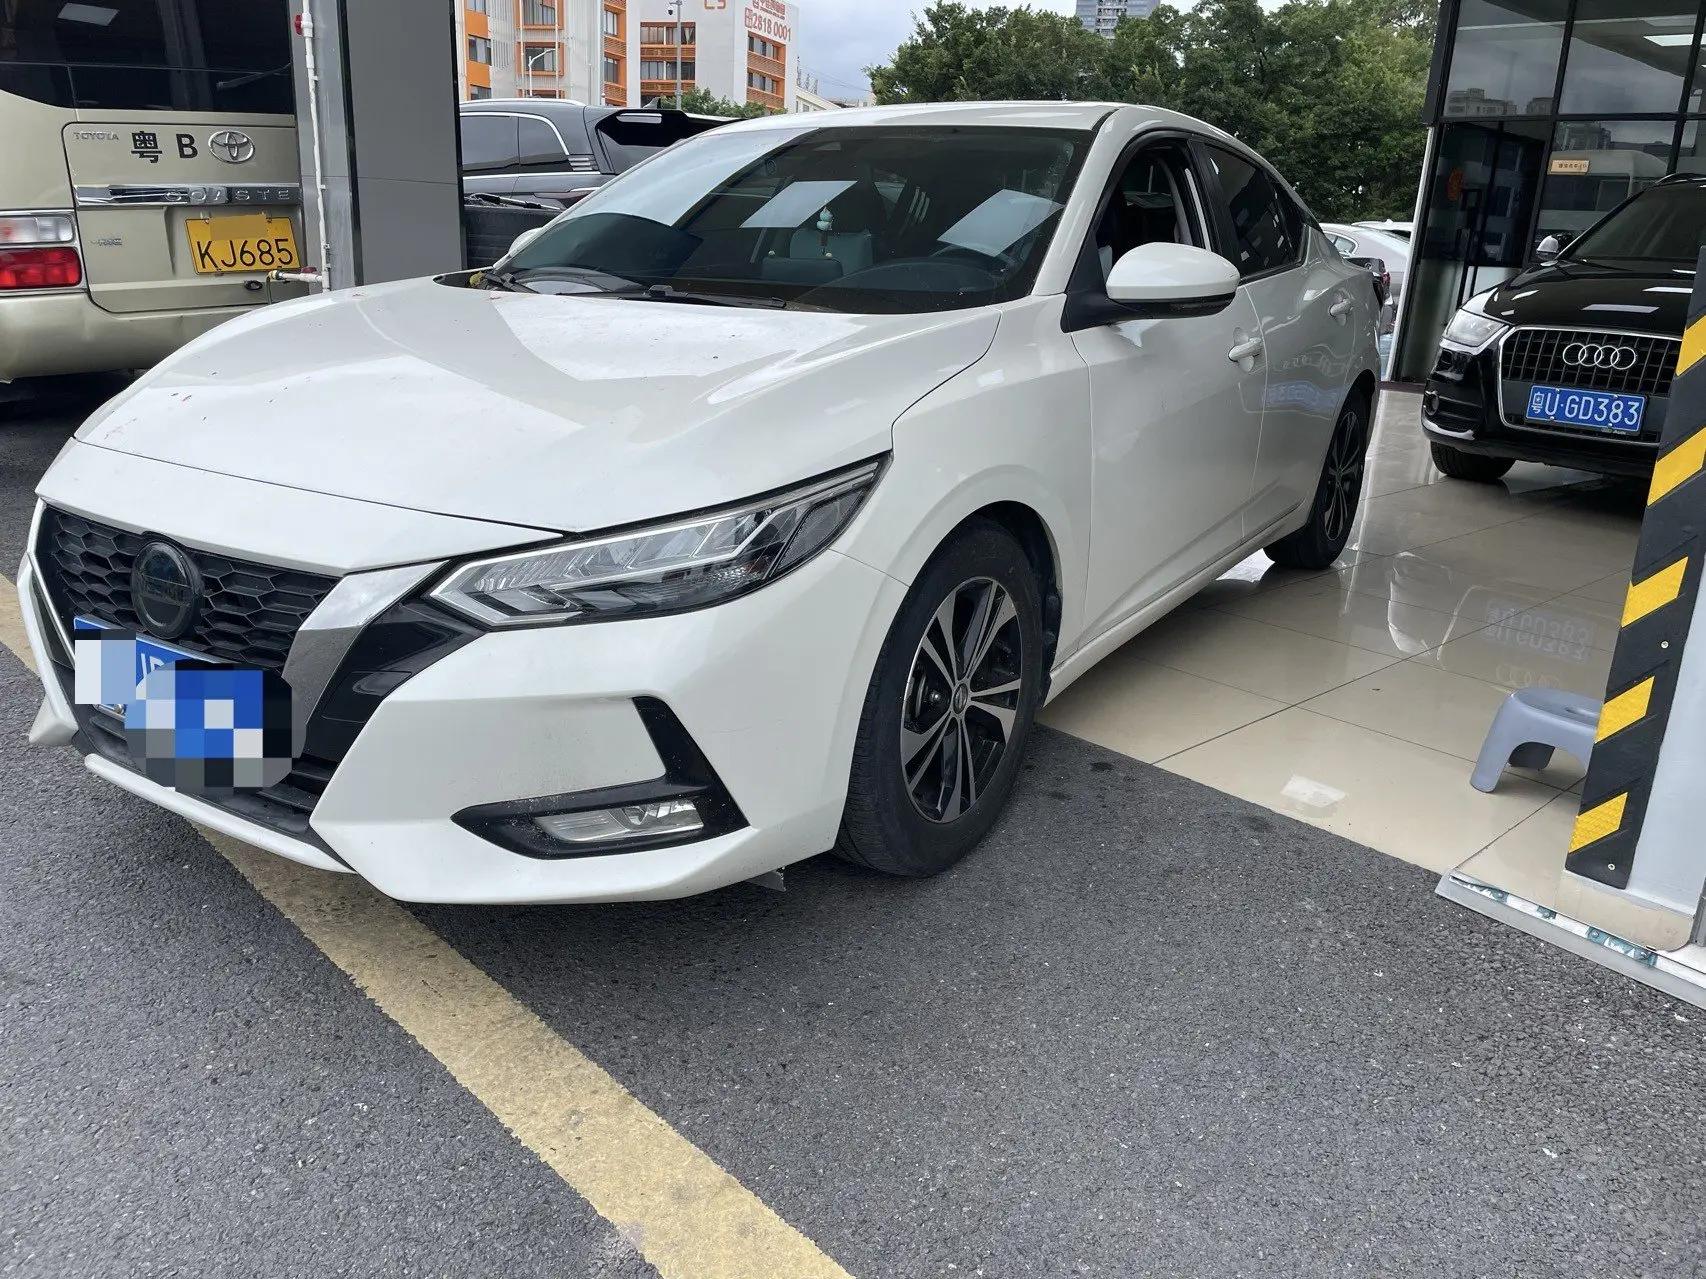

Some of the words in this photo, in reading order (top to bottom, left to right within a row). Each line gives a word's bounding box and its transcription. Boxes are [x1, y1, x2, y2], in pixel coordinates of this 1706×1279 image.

[131, 131, 163, 164] 粤
[176, 134, 198, 159] B
[196, 238, 294, 270] KJ685
